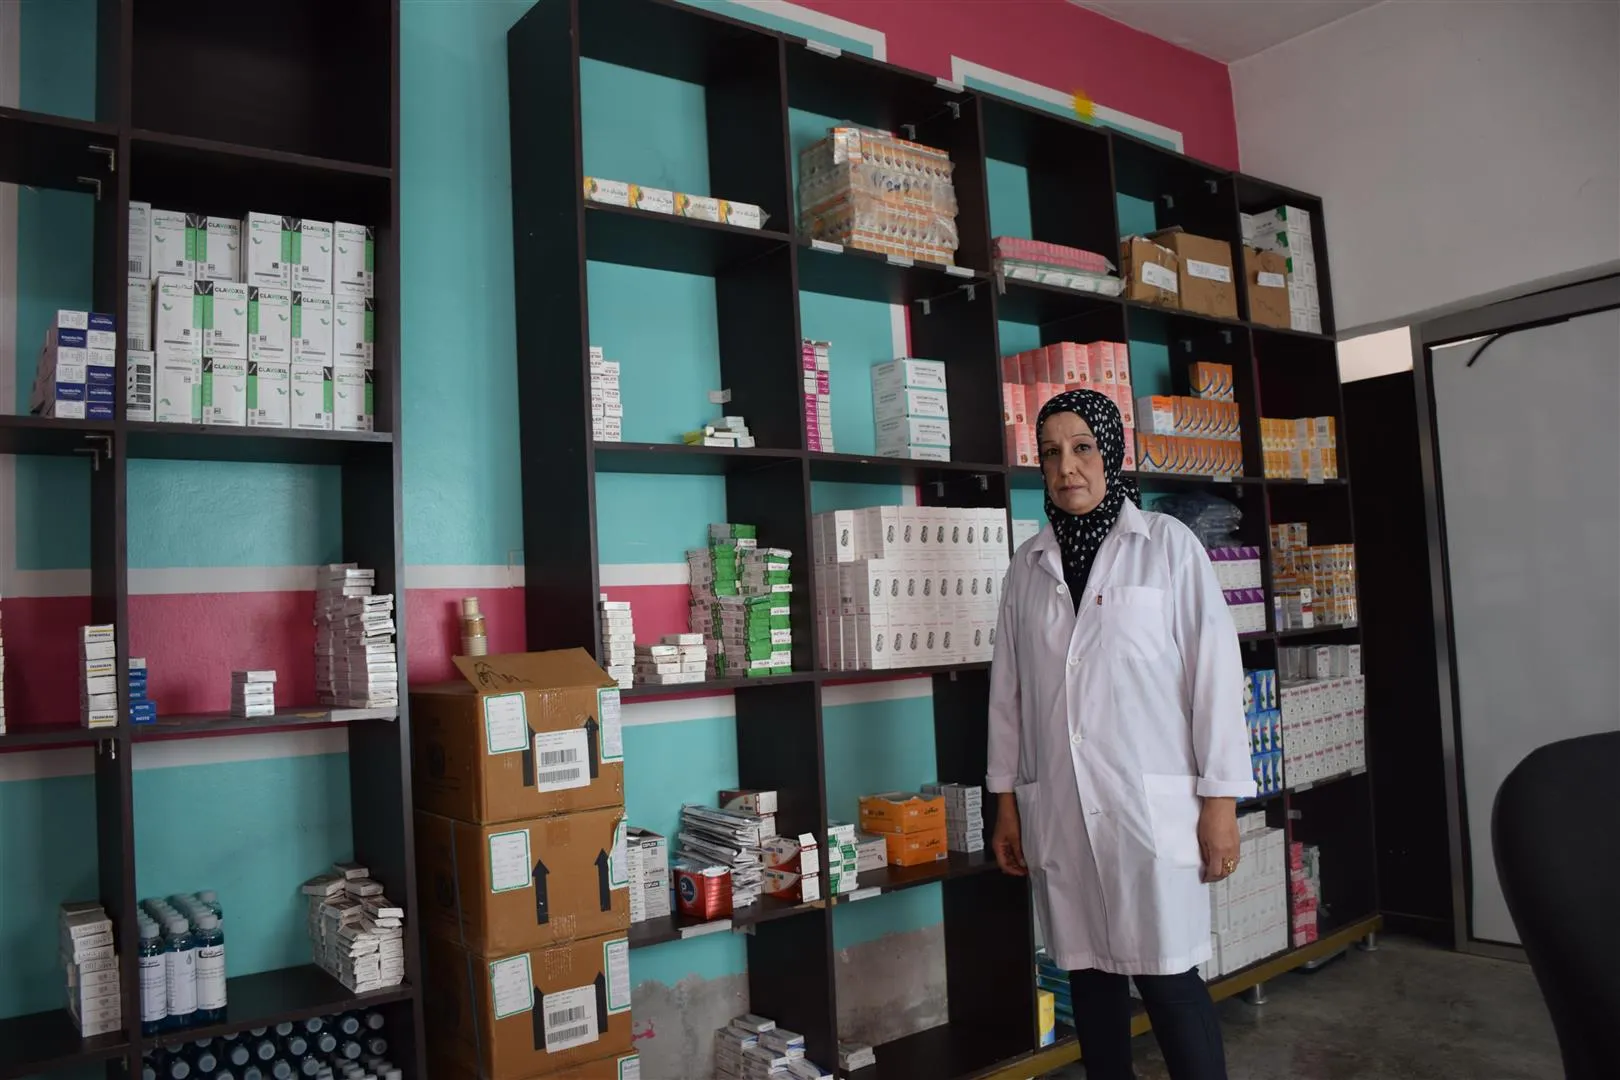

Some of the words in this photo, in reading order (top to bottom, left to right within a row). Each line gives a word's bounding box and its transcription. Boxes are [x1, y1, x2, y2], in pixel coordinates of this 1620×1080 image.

[214, 287, 245, 295] CLAVOXIL
[260, 293, 289, 301] CLAVOXIL
[302, 297, 331, 305] CLAVOXIL
[214, 363, 244, 371] CLAVOXIL
[258, 366, 288, 374] CLAVOXIL
